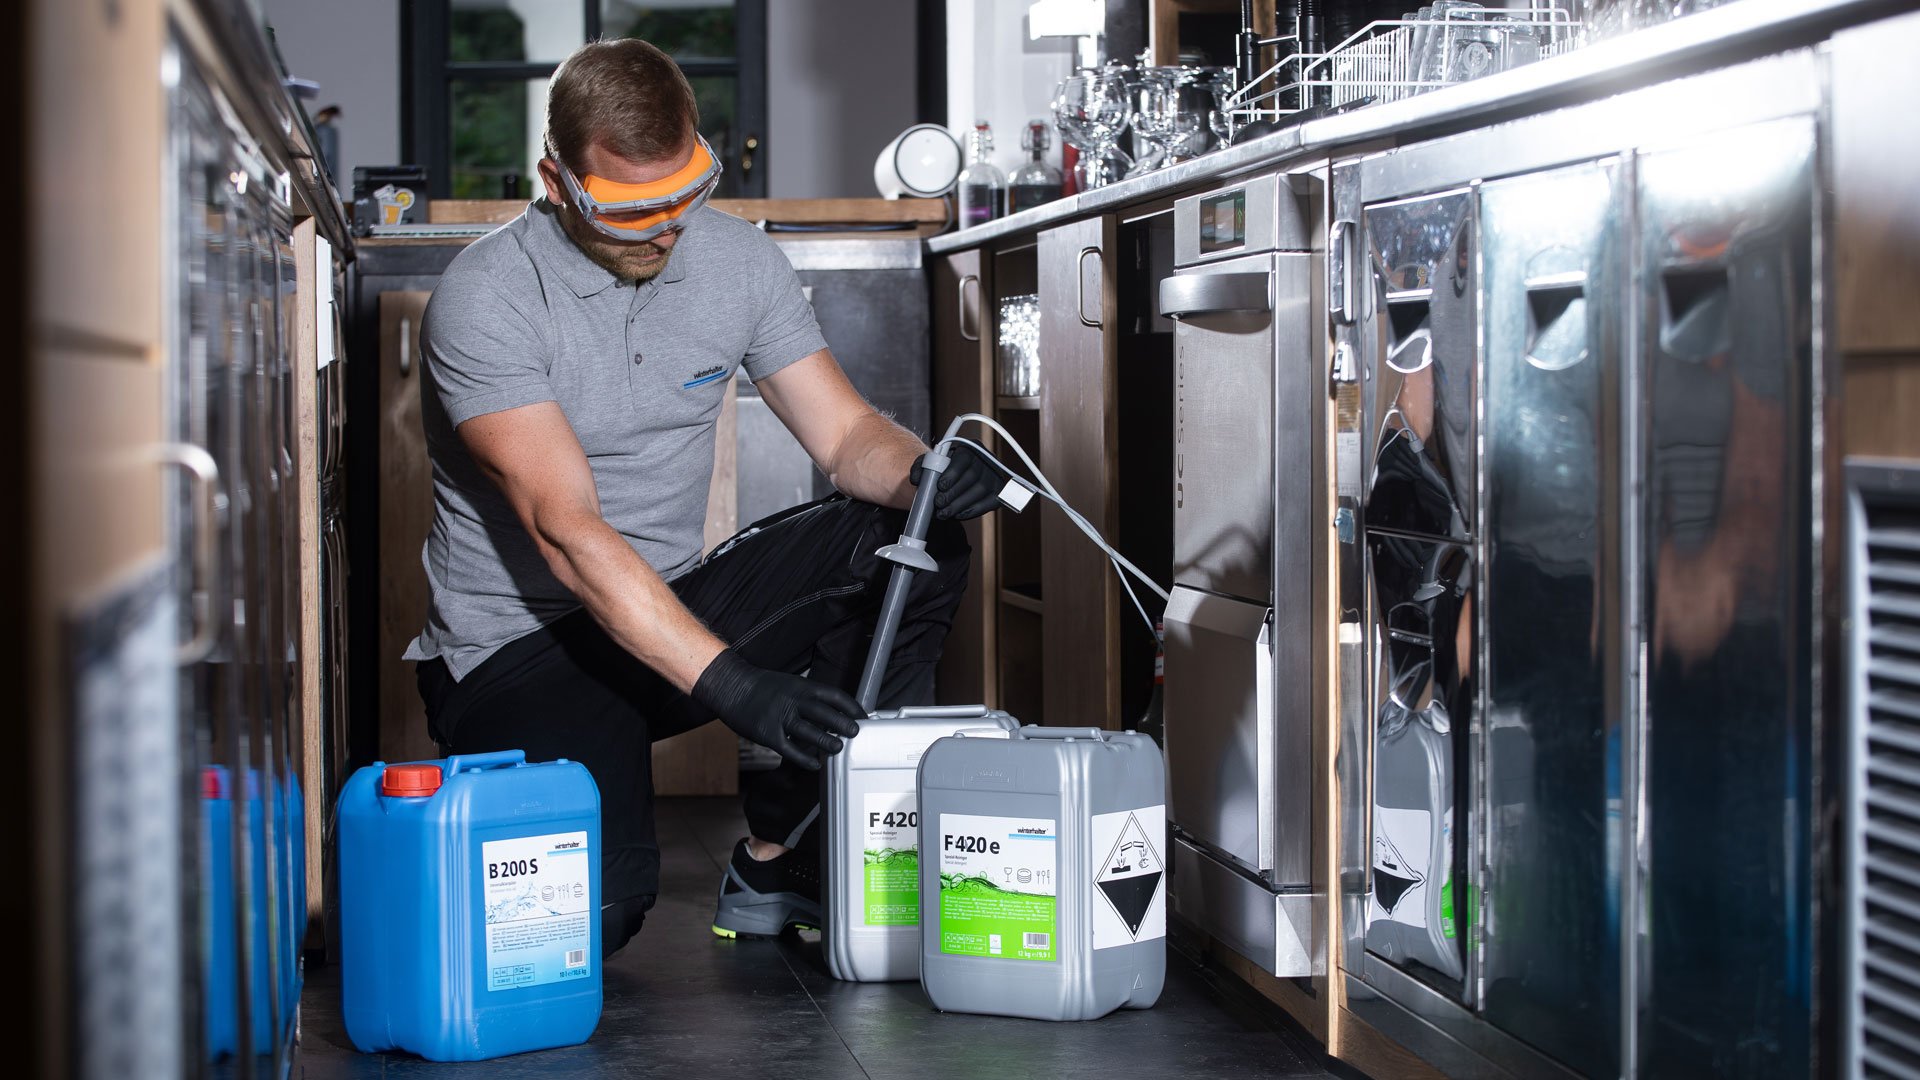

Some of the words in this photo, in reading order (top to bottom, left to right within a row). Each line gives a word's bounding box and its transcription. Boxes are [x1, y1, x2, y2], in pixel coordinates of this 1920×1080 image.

[1177, 454, 1184, 508] UC
[869, 812, 880, 828] F
[882, 811, 918, 828] 420
[1017, 827, 1047, 835] winterhalter
[554, 841, 580, 849] winterhalter
[944, 834, 954, 851] F
[955, 835, 987, 854] 420
[989, 840, 1001, 855] e
[489, 863, 499, 879] B
[501, 859, 527, 878] 200
[529, 858, 538, 875] S
